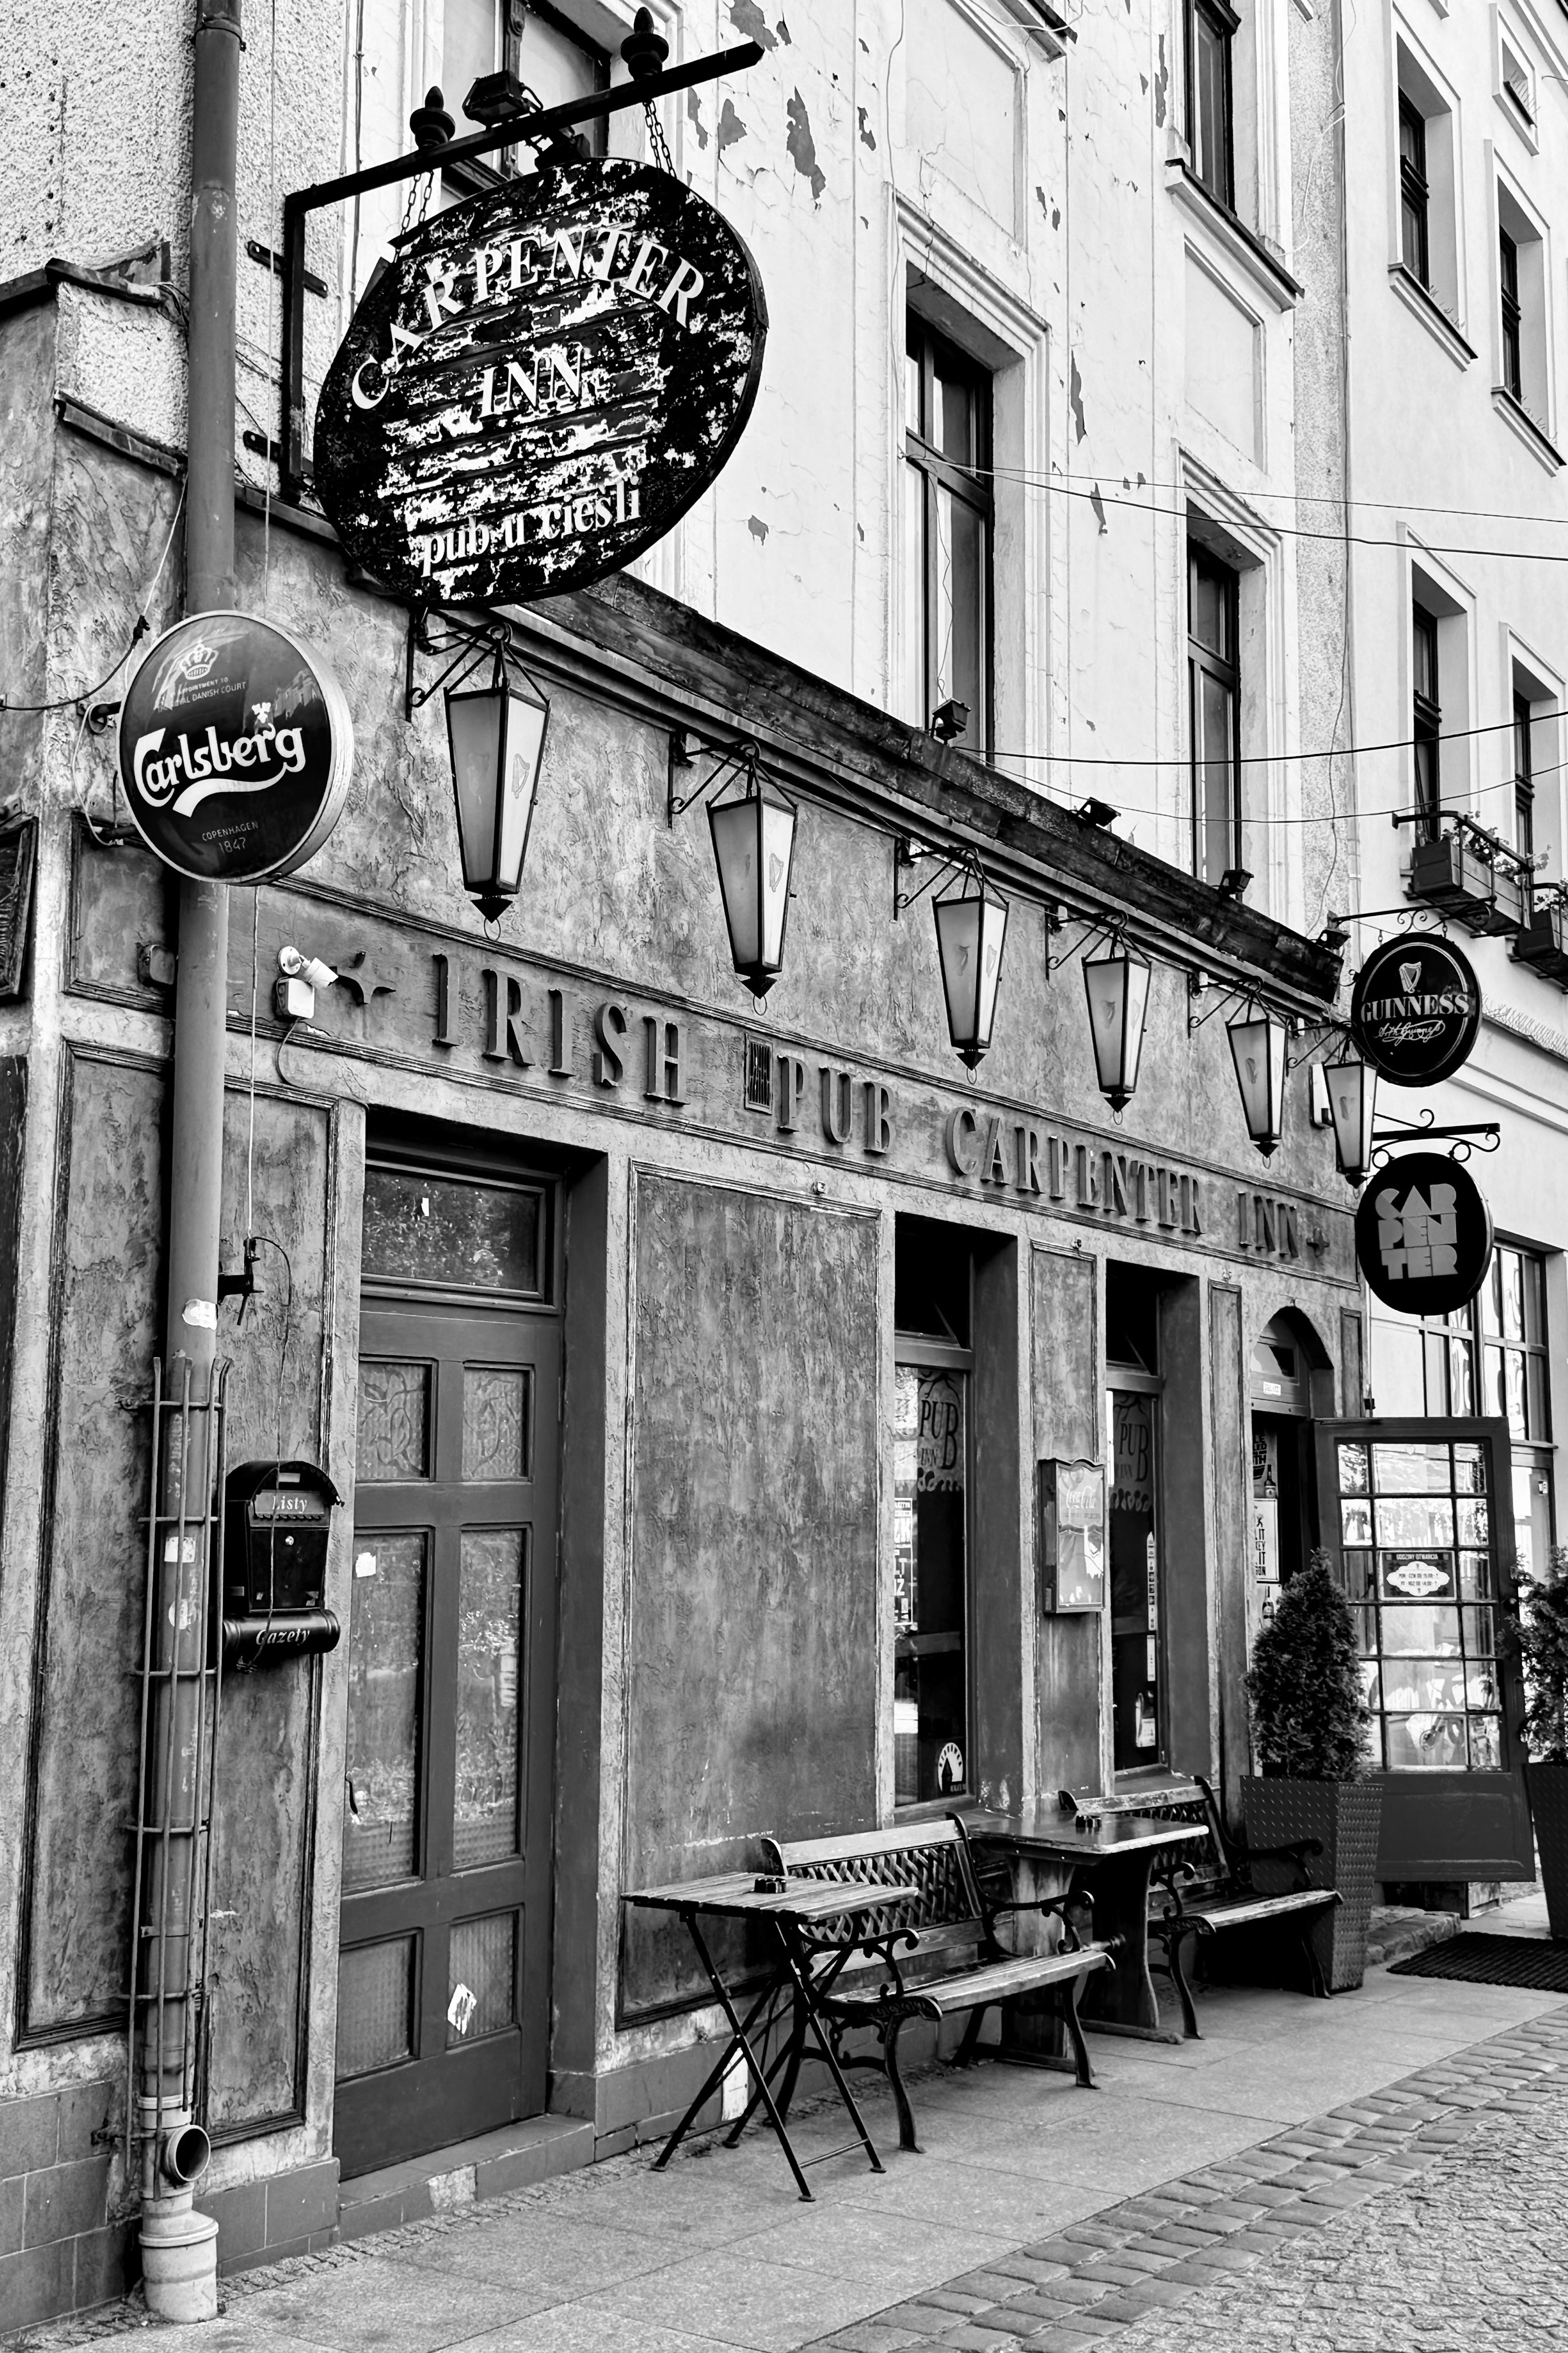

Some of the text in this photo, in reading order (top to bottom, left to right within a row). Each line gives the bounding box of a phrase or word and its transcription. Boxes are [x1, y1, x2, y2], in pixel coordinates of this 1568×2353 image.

[352, 227, 705, 410] CARPENTER
[479, 341, 584, 418] INN
[421, 515, 490, 578] pub
[503, 511, 531, 548] u
[192, 689, 219, 701] DANISH
[221, 681, 246, 694] COURT
[134, 723, 306, 807] Carlsberg
[202, 821, 258, 841] COPENHAGEN
[218, 837, 246, 854] 1847
[1361, 994, 1469, 1023] GUINNESS
[432, 953, 1298, 1258] IRISH PUB CARPENTER INN
[1375, 1183, 1457, 1220] CAR
[1378, 1213, 1458, 1250] PEN
[1381, 1245, 1459, 1280] TER
[919, 1399, 959, 1470] PUB
[1118, 1423, 1149, 1482] PUB
[272, 1495, 307, 1514] Listy
[256, 1628, 310, 1646] Gazety
